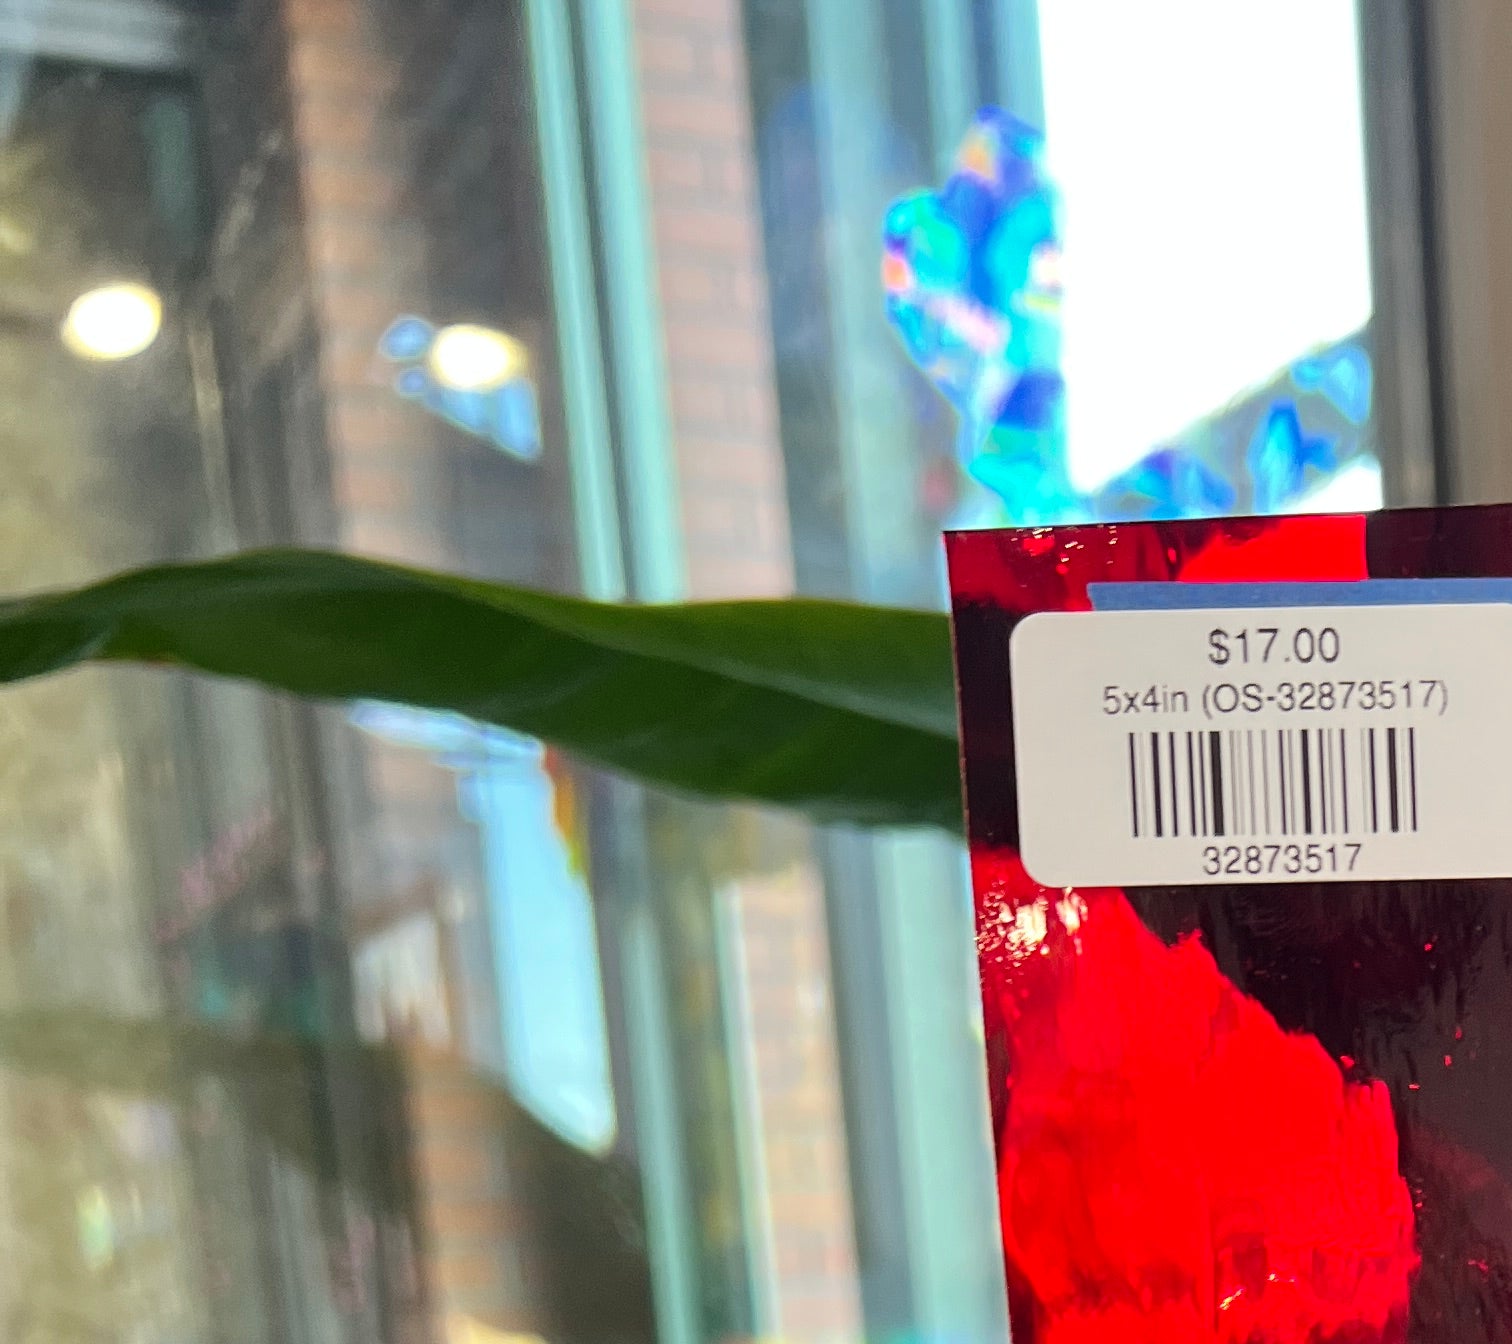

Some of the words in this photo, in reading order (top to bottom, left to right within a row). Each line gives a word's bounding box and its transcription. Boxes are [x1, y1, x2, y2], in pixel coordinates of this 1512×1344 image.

[1209, 628, 1339, 665] $17.00
[1104, 686, 1187, 715] 5x4in
[1203, 680, 1446, 718] (OS-32873517)
[1204, 844, 1361, 875] 32873517
